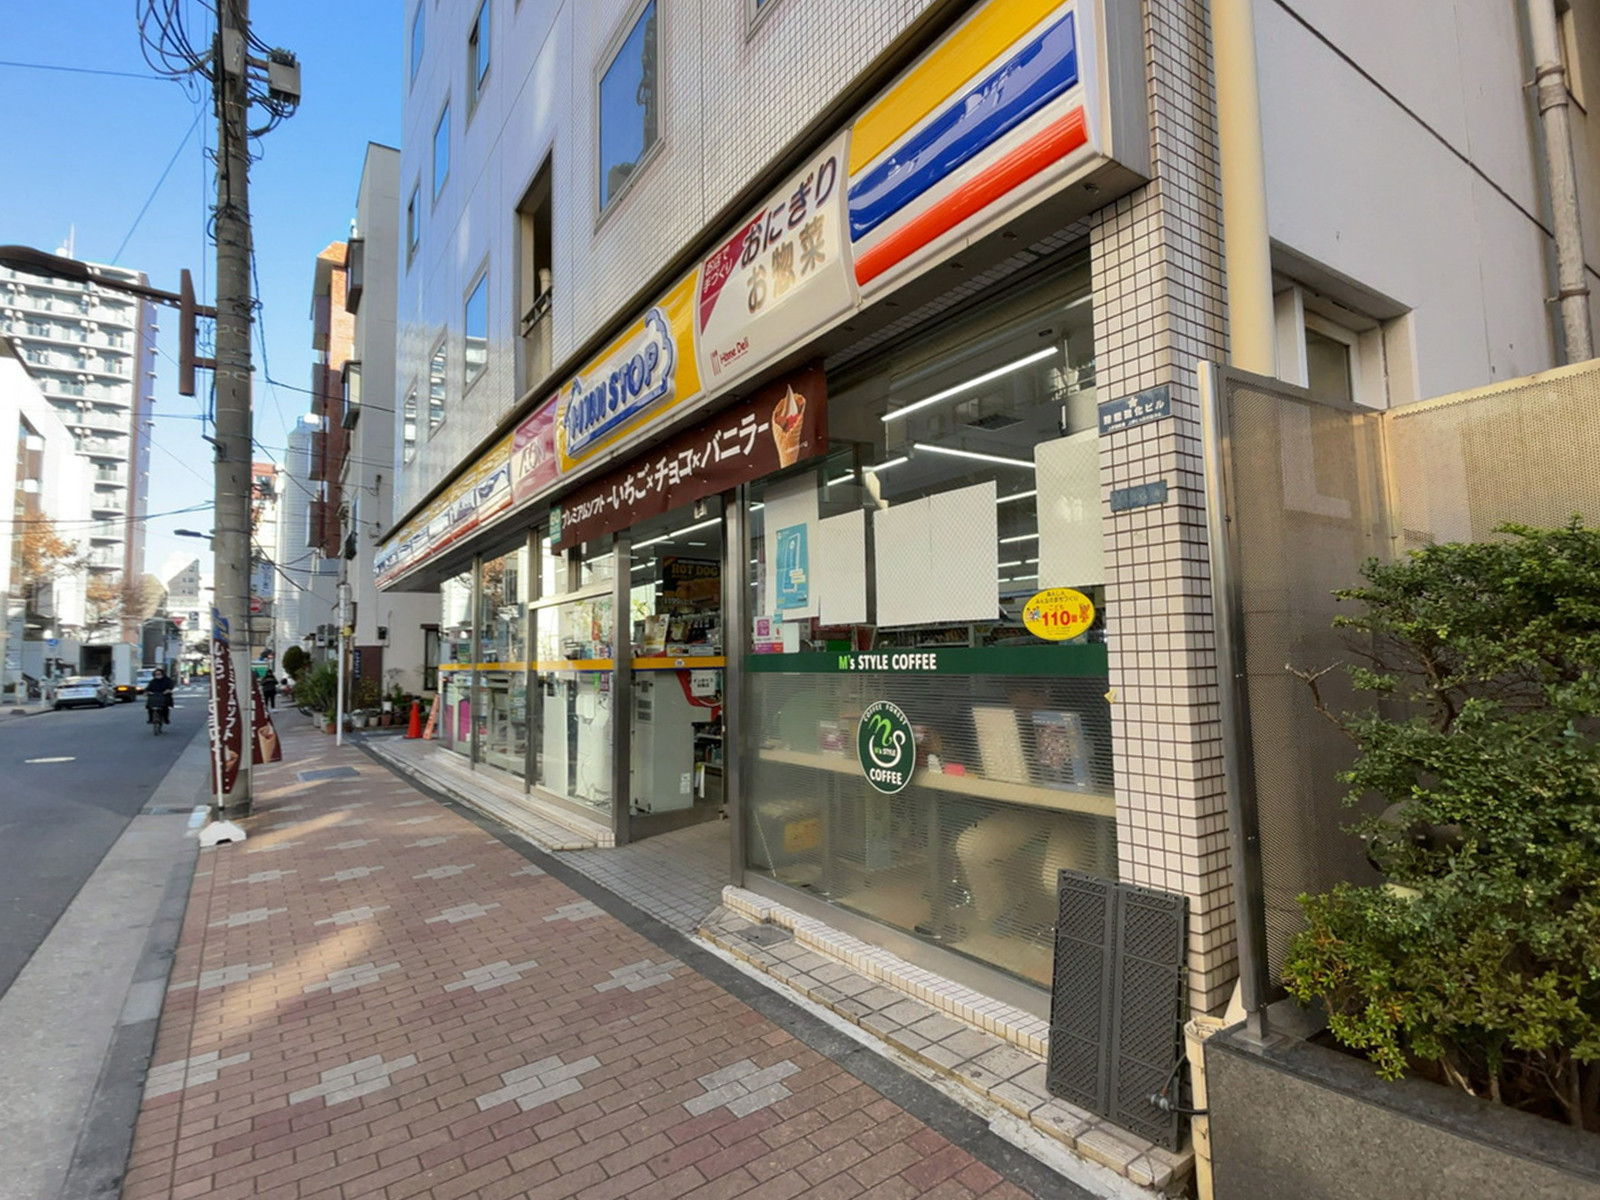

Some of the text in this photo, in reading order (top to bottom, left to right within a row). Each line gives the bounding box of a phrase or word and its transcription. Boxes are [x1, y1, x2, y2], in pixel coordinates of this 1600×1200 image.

[741, 156, 837, 270] おにぎり
[703, 258, 733, 294] 手づくり
[608, 341, 659, 412] STOP
[1103, 400, 1165, 426] 化ビル
[671, 563, 719, 577] HOT DOG
[838, 653, 937, 670] M's STYLE COFFEE
[863, 703, 908, 726] COFFEE FOREST
[869, 768, 903, 786] COFFEE
